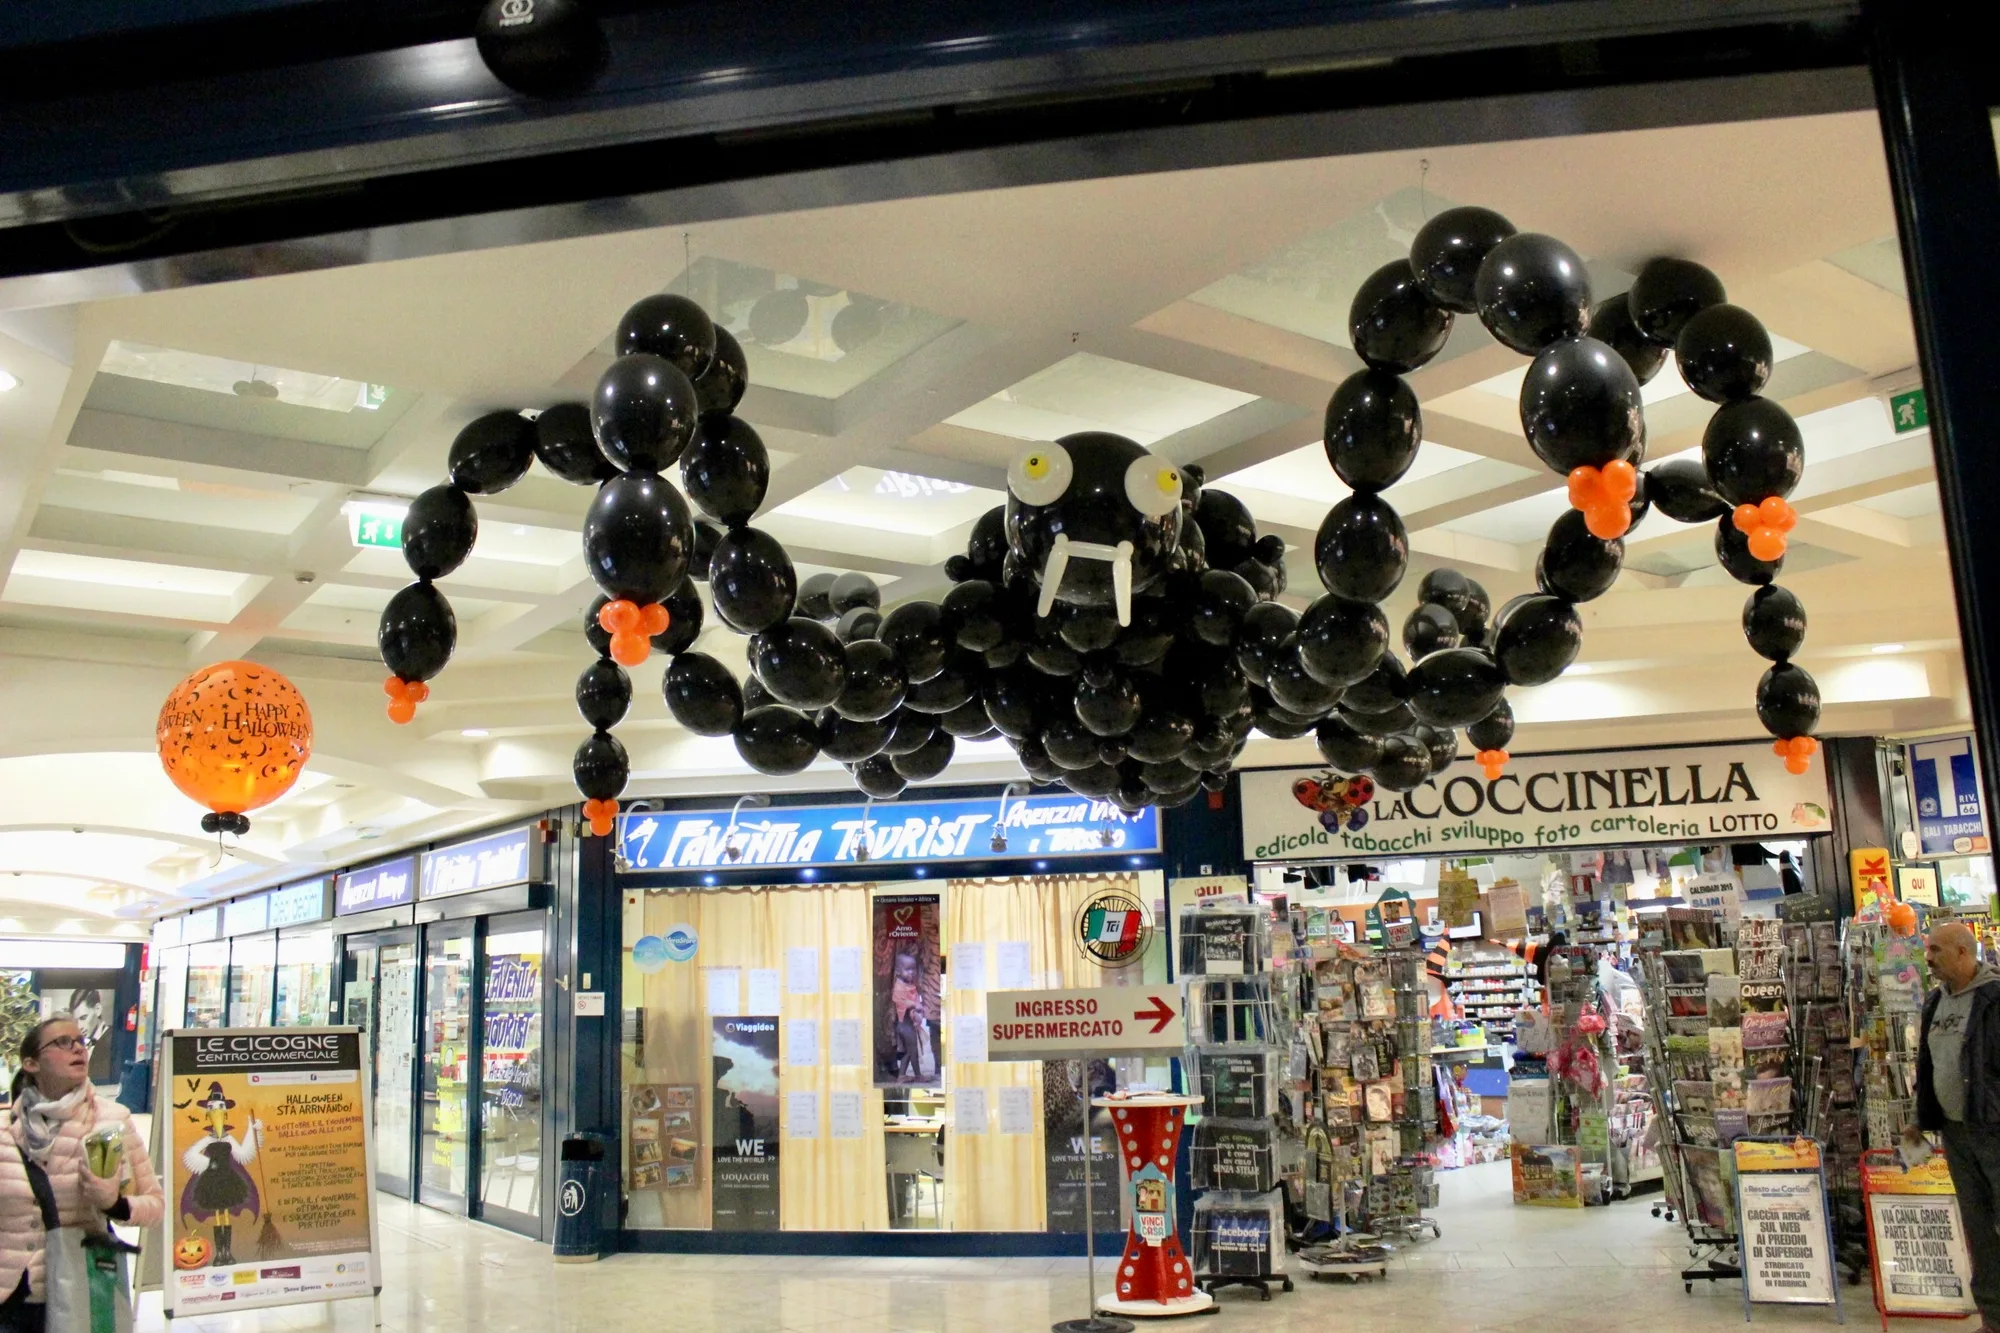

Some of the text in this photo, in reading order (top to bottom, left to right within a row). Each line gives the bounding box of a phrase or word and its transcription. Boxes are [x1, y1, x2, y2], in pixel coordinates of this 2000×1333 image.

[245, 701, 290, 721] HAPPY
[222, 711, 310, 741] HALLOWEEN
[1373, 762, 1760, 821] LA COCCINELLA
[1959, 793, 1977, 803] RIV.
[1963, 805, 1975, 814] 66
[1255, 812, 1778, 859] edicola tabacchi sviluppo foto cartoleria LOTTO
[1923, 821, 1982, 838] SALI TABACCHI
[659, 819, 822, 868] FAVENTIA
[1202, 866, 1208, 874] 4
[1912, 878, 1925, 890] QUI
[1738, 925, 1778, 940] ROLLING
[1740, 953, 1778, 970] ROLLING
[1740, 964, 1778, 980] STONES
[1742, 984, 1782, 997] Queen
[1015, 998, 1098, 1018] INGRESSO
[736, 1022, 775, 1033] Viaggidea
[992, 1020, 1123, 1041] SUPERMERCATO
[196, 1036, 339, 1053] LE CICOGNE
[196, 1050, 339, 1063] CENTRO COMMERCIALE
[286, 1094, 343, 1105] HALLOWEEN
[277, 1103, 353, 1116] STA ARRIVANDO!
[282, 1121, 310, 1130] OTTOBRE
[1684, 1124, 1718, 1140] ROSSI
[736, 1139, 765, 1156] WE
[1070, 1137, 1103, 1155] WE
[1141, 1216, 1163, 1227] VINCI
[1748, 1210, 1811, 1221] CACCIA ANCHE
[1881, 1209, 1951, 1225] VIA CANAL GRANDE
[1218, 1225, 1260, 1238] facebook
[1760, 1222, 1801, 1233] SUL WEB
[1884, 1225, 1954, 1241] PARTE IL CANTIERE
[1756, 1234, 1807, 1246] AI PREDONI
[1753, 1247, 1814, 1259] DI SUPERBICI
[1894, 1241, 1948, 1258] PER LA NUOVA
[1765, 1262, 1805, 1270] STRONCATO
[1893, 1257, 1955, 1274] PISTA CICLABILE
[1783, 1271, 1811, 1279] INFARTO
[1774, 1280, 1807, 1288] FABBRICA
